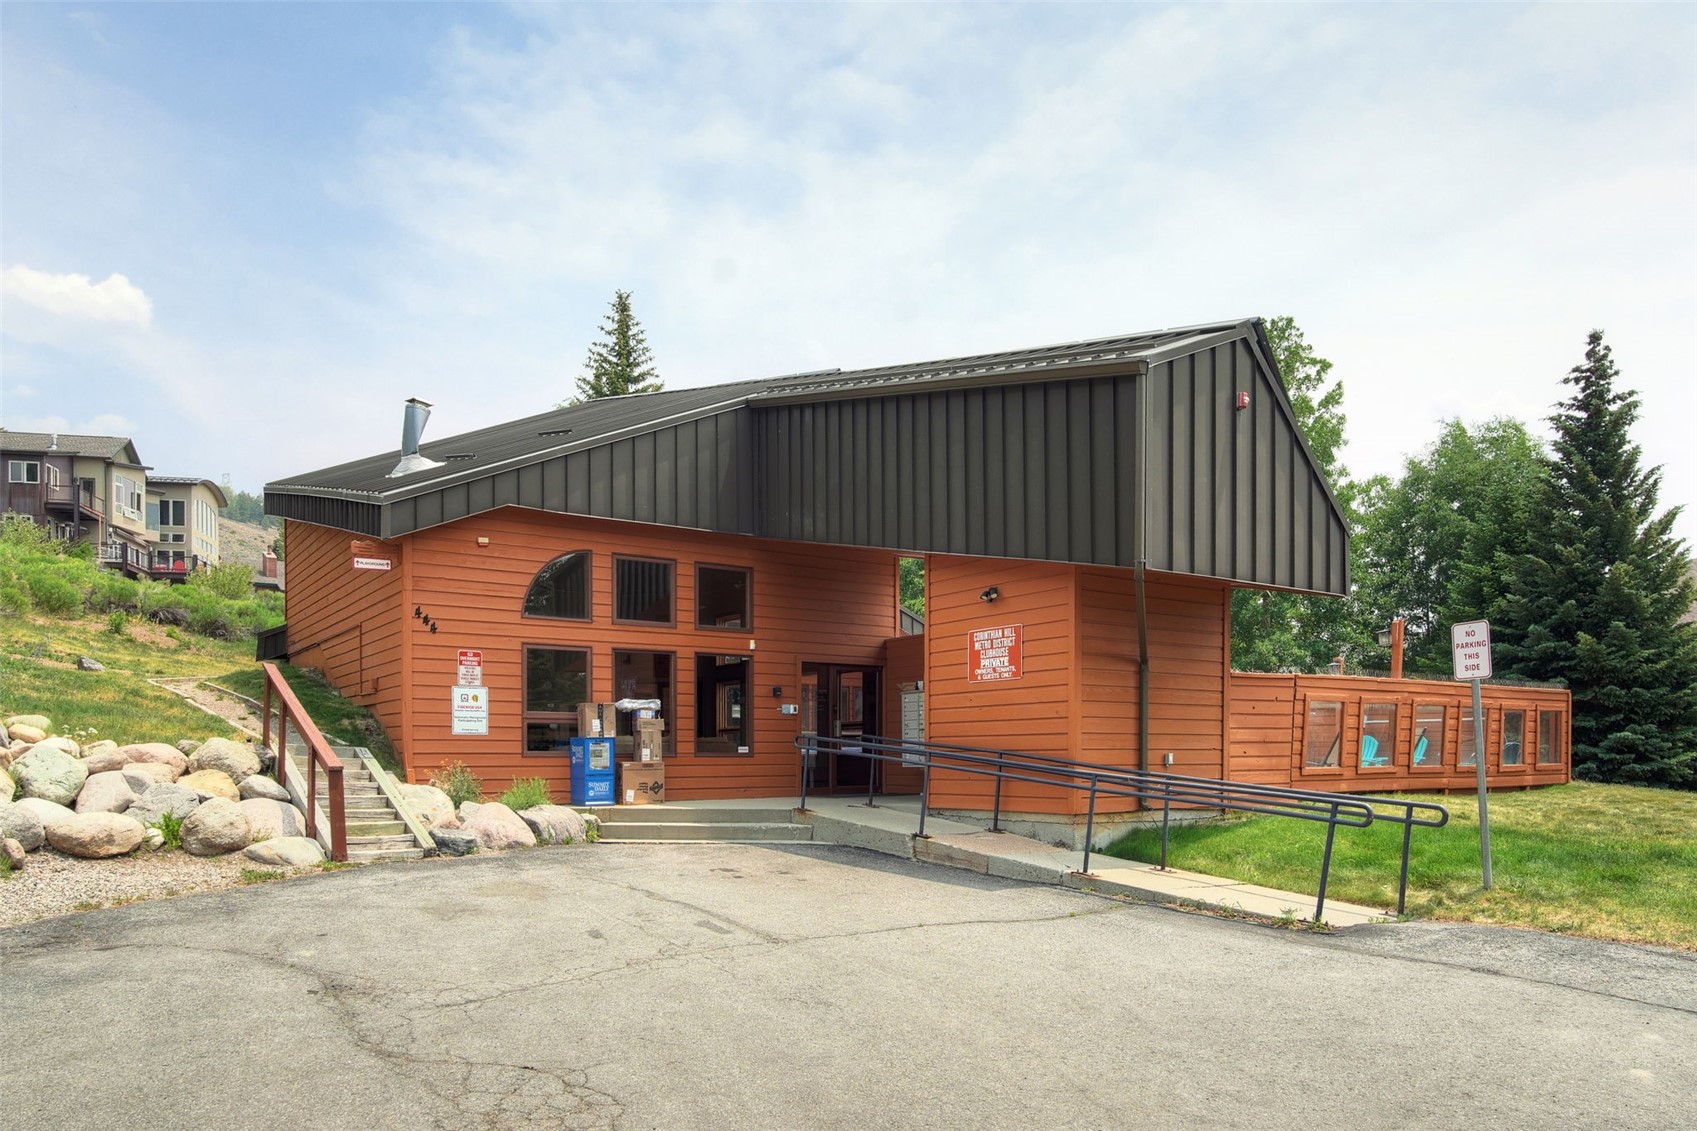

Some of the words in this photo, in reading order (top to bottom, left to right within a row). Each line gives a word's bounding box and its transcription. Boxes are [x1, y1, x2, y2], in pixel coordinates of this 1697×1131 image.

[974, 629, 1003, 641] CORINTHIAN
[1004, 627, 1016, 637] HILL
[1465, 629, 1476, 637] NO
[975, 640, 991, 650] METRO
[993, 637, 1015, 648] DISTRICT
[1455, 640, 1487, 650] PARKING
[980, 647, 1009, 658] CLUBHOUSE
[1463, 652, 1480, 660] THIS
[980, 656, 1009, 669] PRIVATE
[1464, 663, 1481, 672] SIDE
